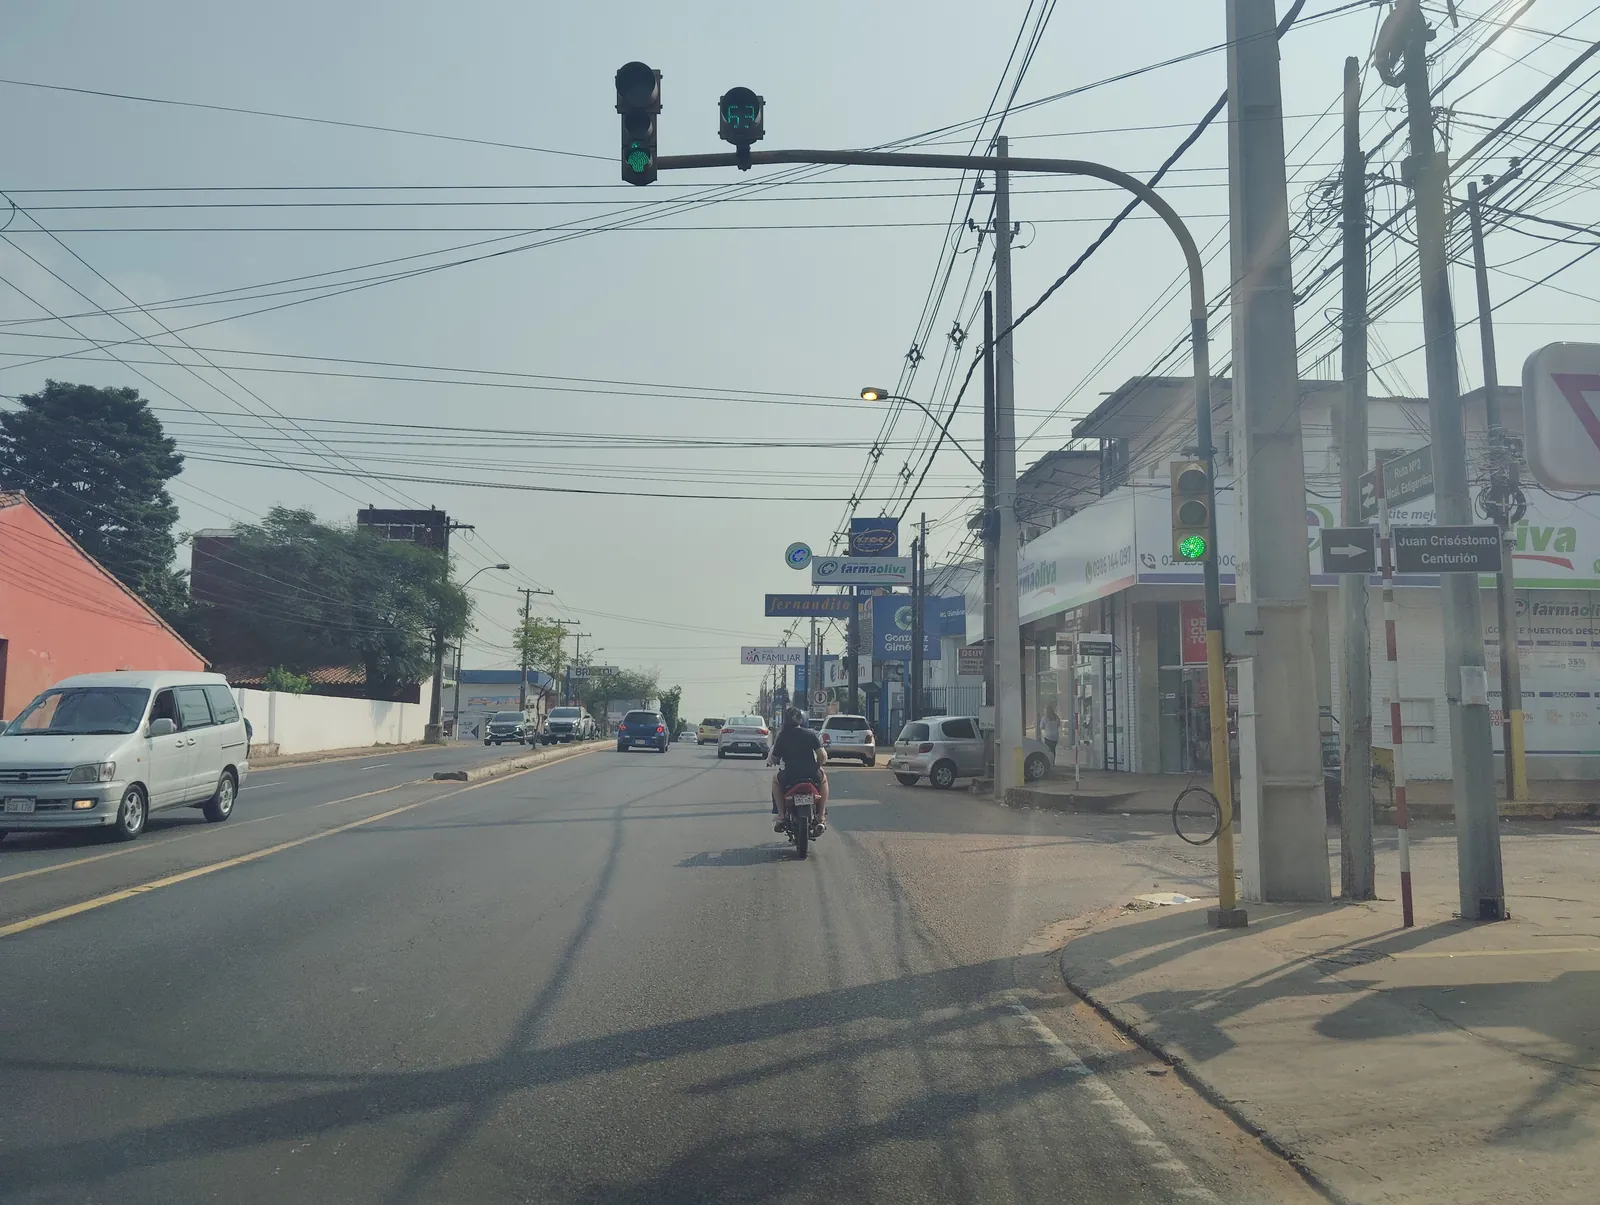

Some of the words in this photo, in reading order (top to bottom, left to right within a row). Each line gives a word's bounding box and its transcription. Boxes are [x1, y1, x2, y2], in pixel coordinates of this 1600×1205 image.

[1394, 465, 1409, 479] Ruta
[1399, 536, 1427, 546] Juan
[1430, 534, 1497, 546] Crisóstomo
[1421, 552, 1478, 565] Centurión
[840, 564, 907, 574] farmaoliva
[769, 597, 850, 613] fernandita
[1532, 602, 1600, 617] farmaoli
[884, 642, 929, 651] Giméz
[761, 653, 801, 662] FAMILIAR
[961, 649, 984, 657] DELIV
